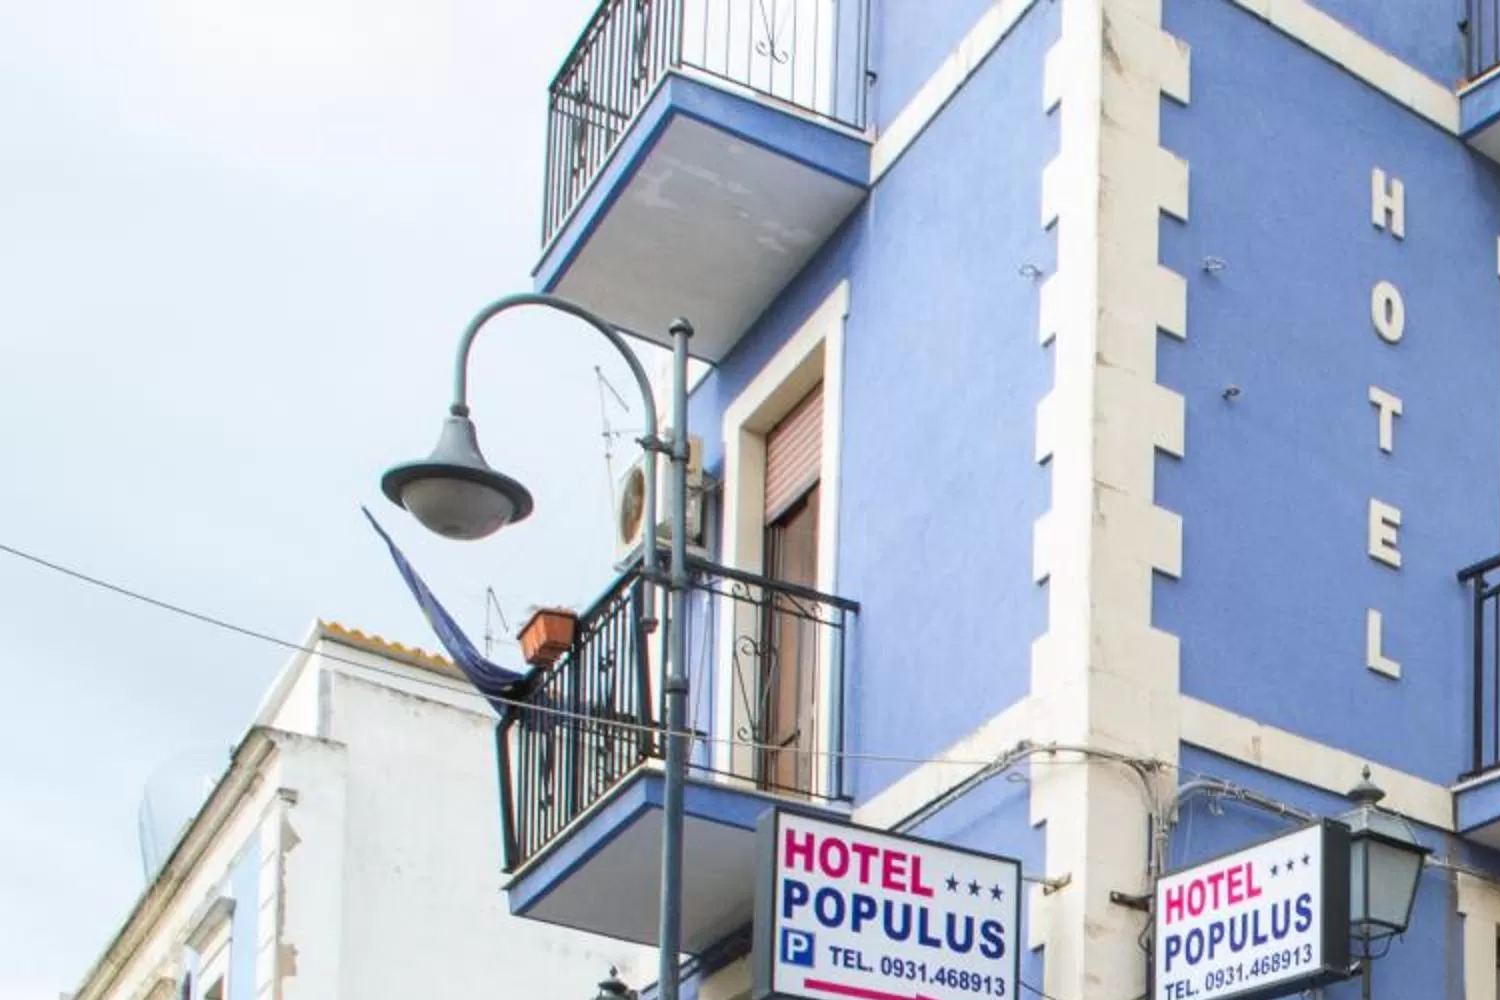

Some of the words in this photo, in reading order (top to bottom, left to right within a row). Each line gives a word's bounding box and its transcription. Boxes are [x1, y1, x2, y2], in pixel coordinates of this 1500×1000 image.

[1367, 166, 1405, 679] HOTEL
[784, 827, 935, 898] HOTEL
[1165, 861, 1263, 925] HOTEL
[783, 878, 1006, 960] POPULUS
[1164, 892, 1314, 973] POPULUS
[787, 932, 809, 961] P
[829, 945, 874, 972] TEL.
[880, 955, 1006, 997] 0931.468913
[1205, 943, 1314, 992] 0931.468913
